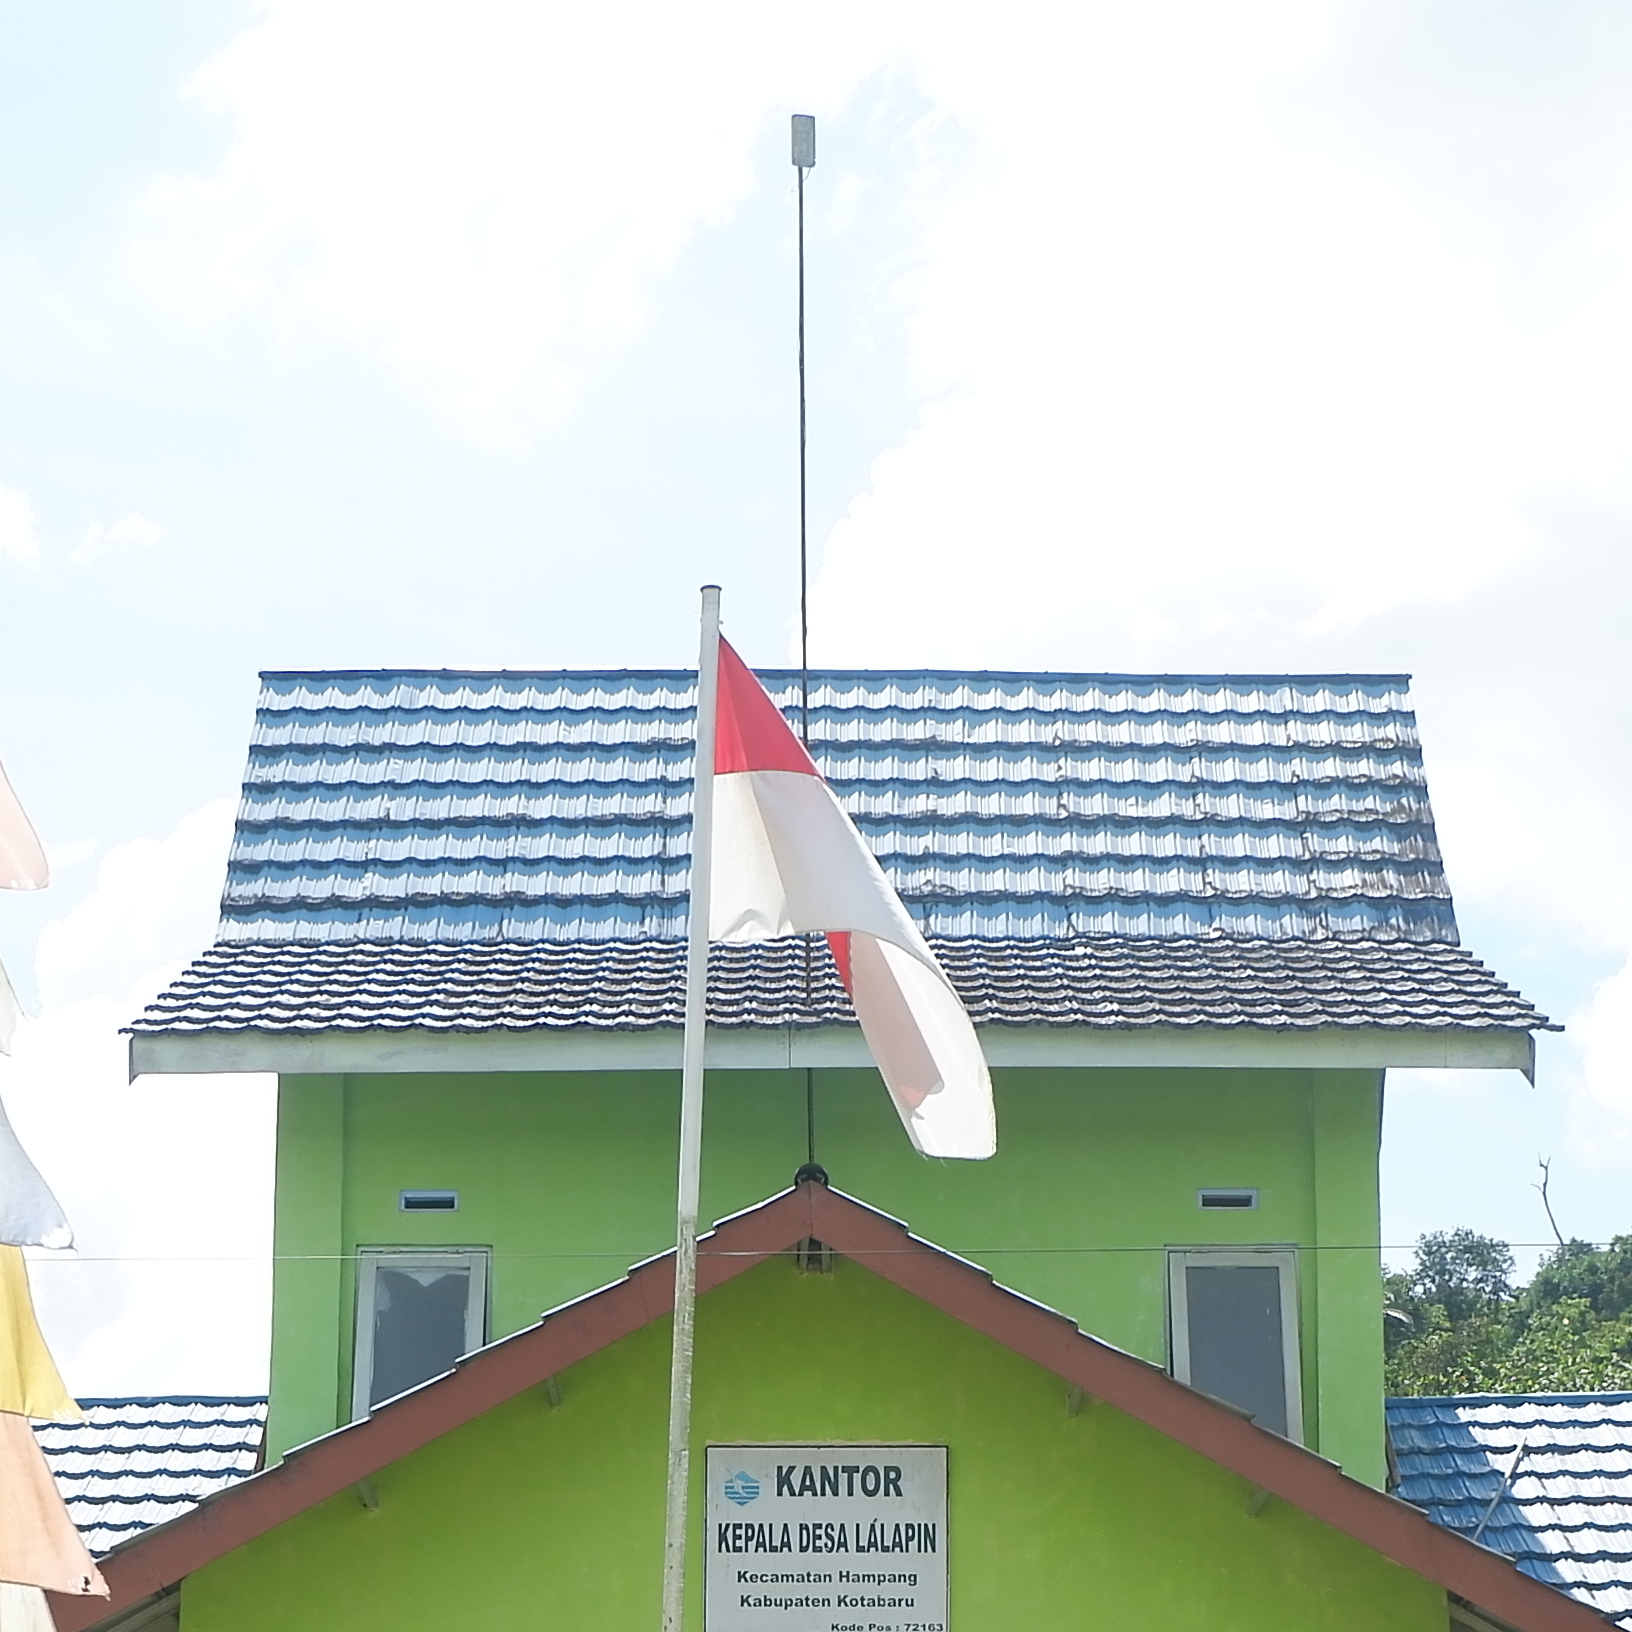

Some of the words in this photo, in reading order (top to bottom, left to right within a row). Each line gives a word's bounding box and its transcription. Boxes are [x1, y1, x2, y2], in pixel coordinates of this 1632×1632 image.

[776, 1465, 903, 1497] KANTOR
[717, 1522, 792, 1553] KEPALA
[798, 1522, 850, 1553] DESA
[736, 1570, 832, 1584] Kecamatan
[838, 1570, 918, 1586] Hampang
[740, 1594, 831, 1610] Kabupaten
[837, 1594, 915, 1607] Kotabaru
[831, 1623, 864, 1632] Kode
[868, 1623, 892, 1632] Pos
